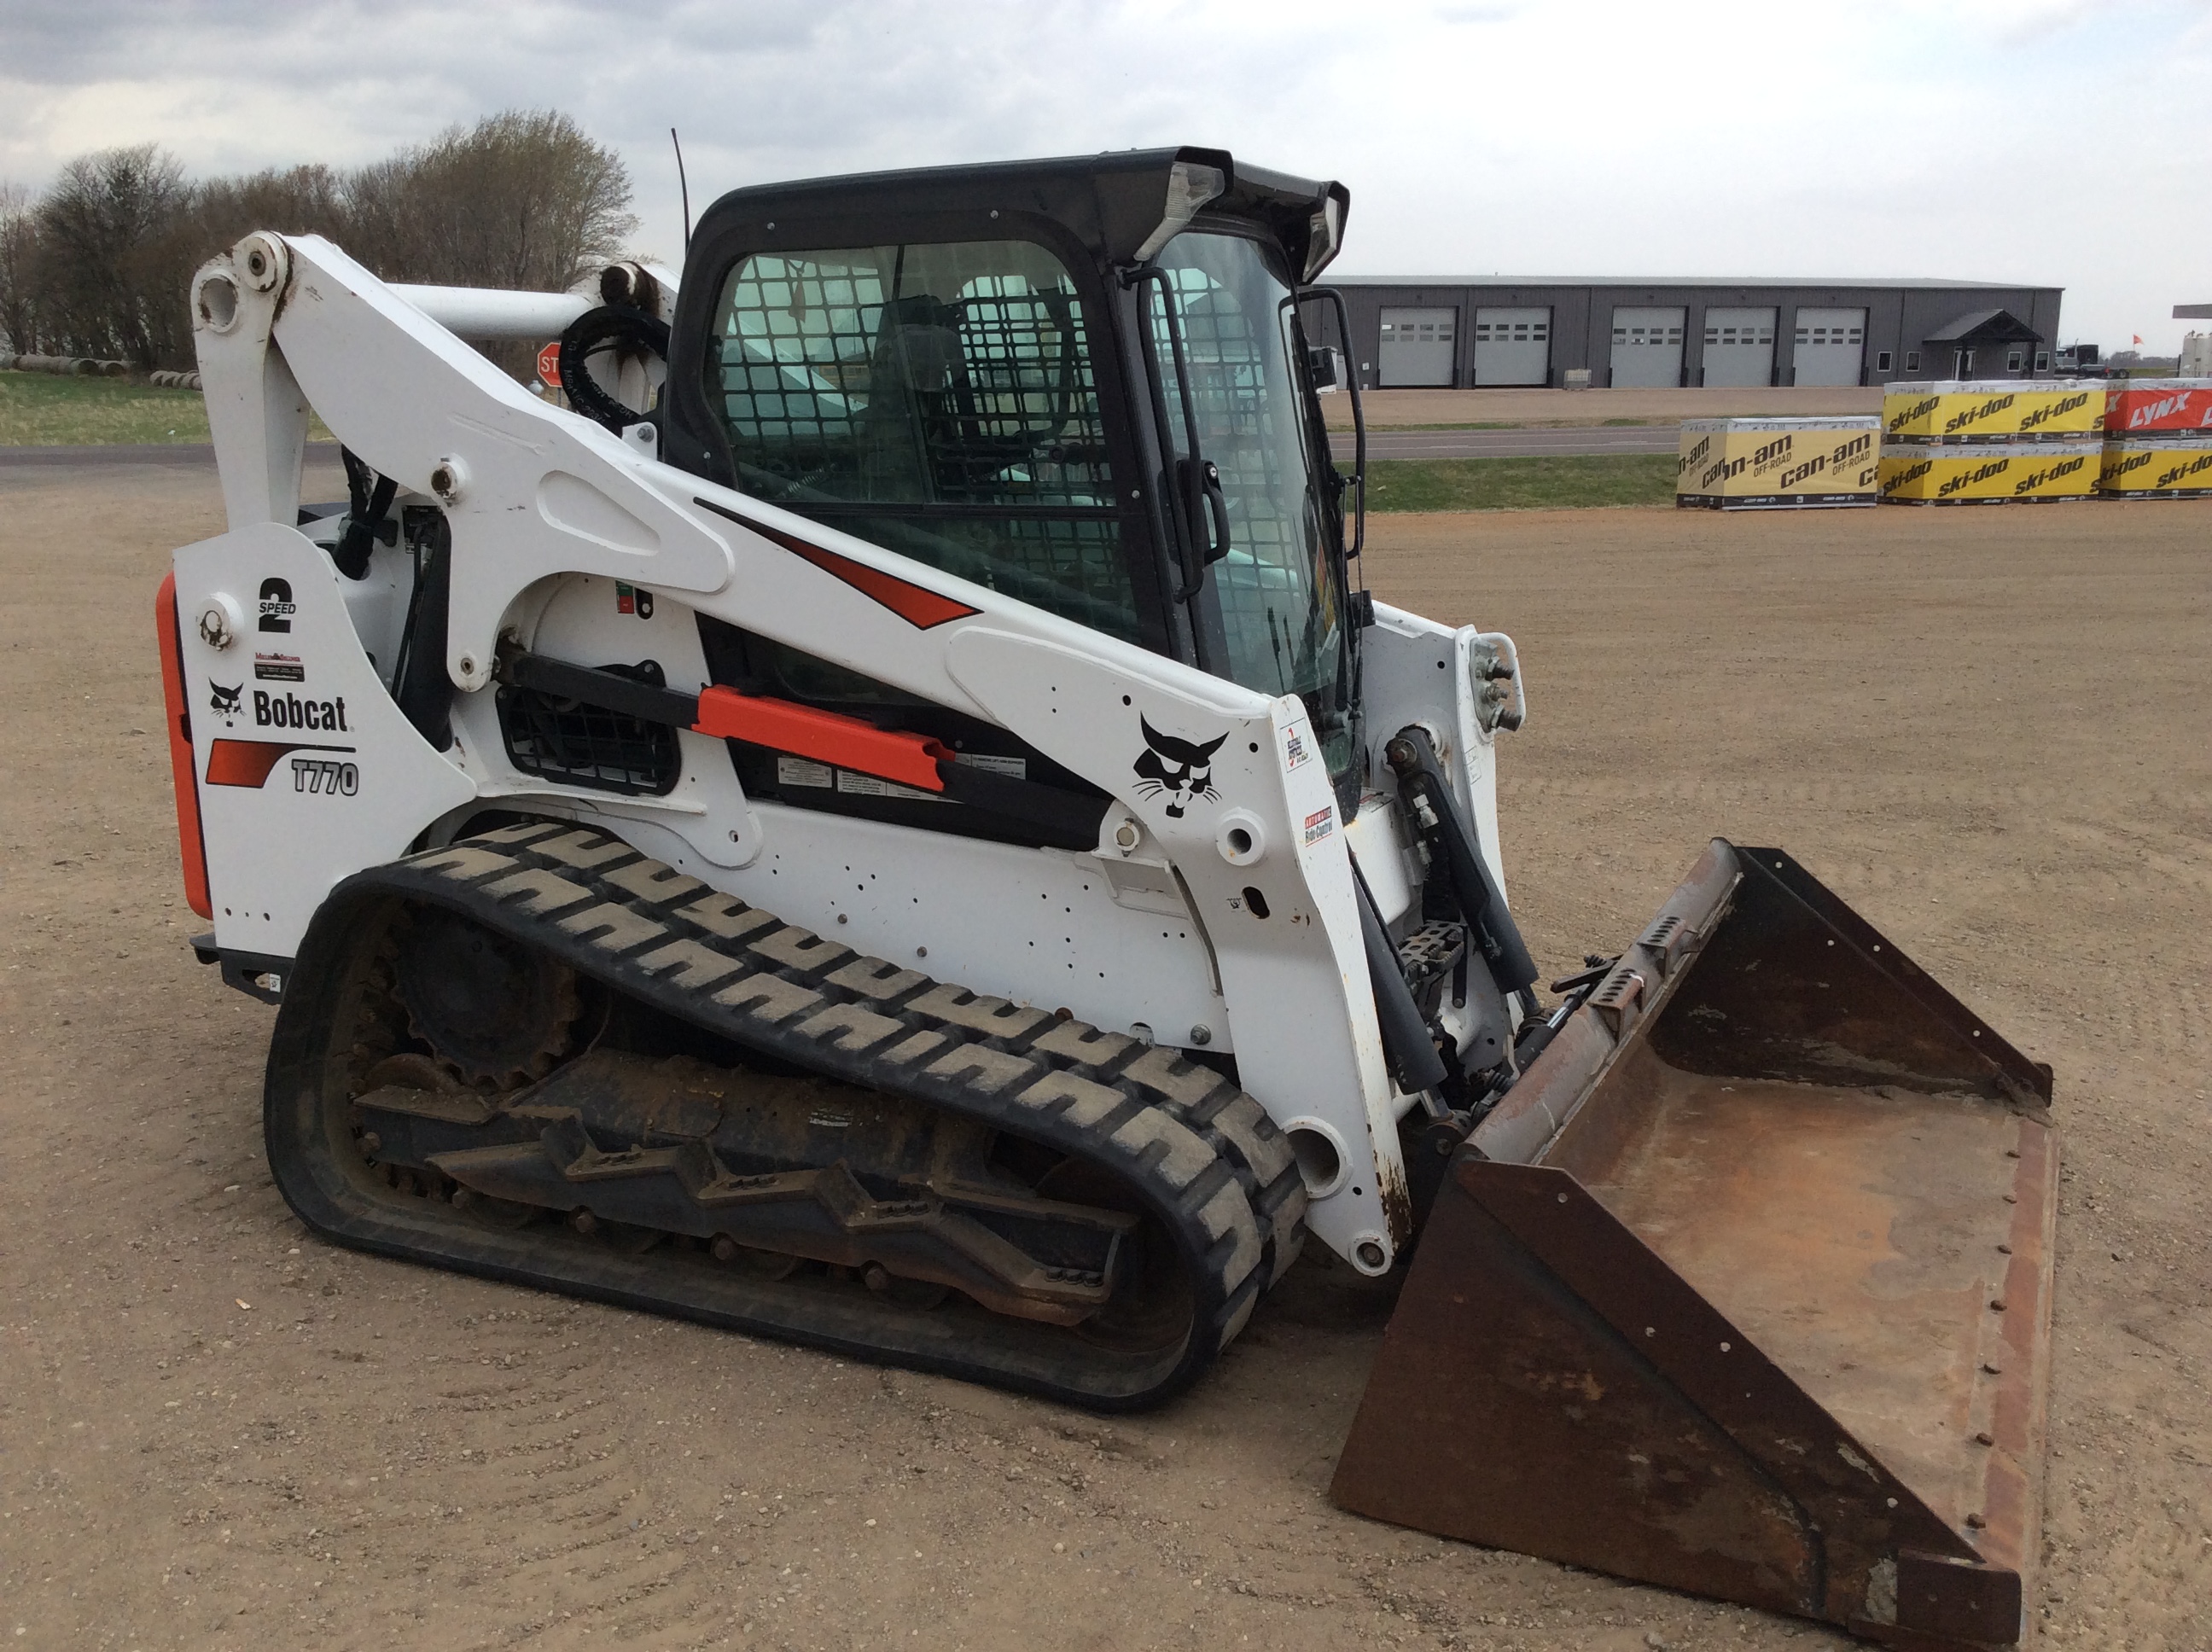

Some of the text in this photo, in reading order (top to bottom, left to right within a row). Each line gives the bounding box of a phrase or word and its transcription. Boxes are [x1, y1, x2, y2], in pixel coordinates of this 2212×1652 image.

[541, 356, 559, 373] ST
[1889, 396, 1940, 433] ski-doo
[1945, 394, 2015, 433] ski-doo
[2019, 393, 2088, 431] ski-doo
[2129, 391, 2192, 428] LYNX
[1754, 452, 1791, 477] OFF-ROAD
[1780, 433, 1871, 489] can-am
[1832, 451, 1870, 475] OFF-ROAD
[1883, 460, 1933, 496] ski-doo
[1938, 458, 2009, 497] ski-doo
[2015, 457, 2084, 495] ski-doo
[2156, 455, 2212, 488] ski-do
[259, 577, 293, 633] 2
[259, 602, 297, 614] SPEED
[253, 690, 348, 732] Bobcat
[291, 759, 359, 797] T770
